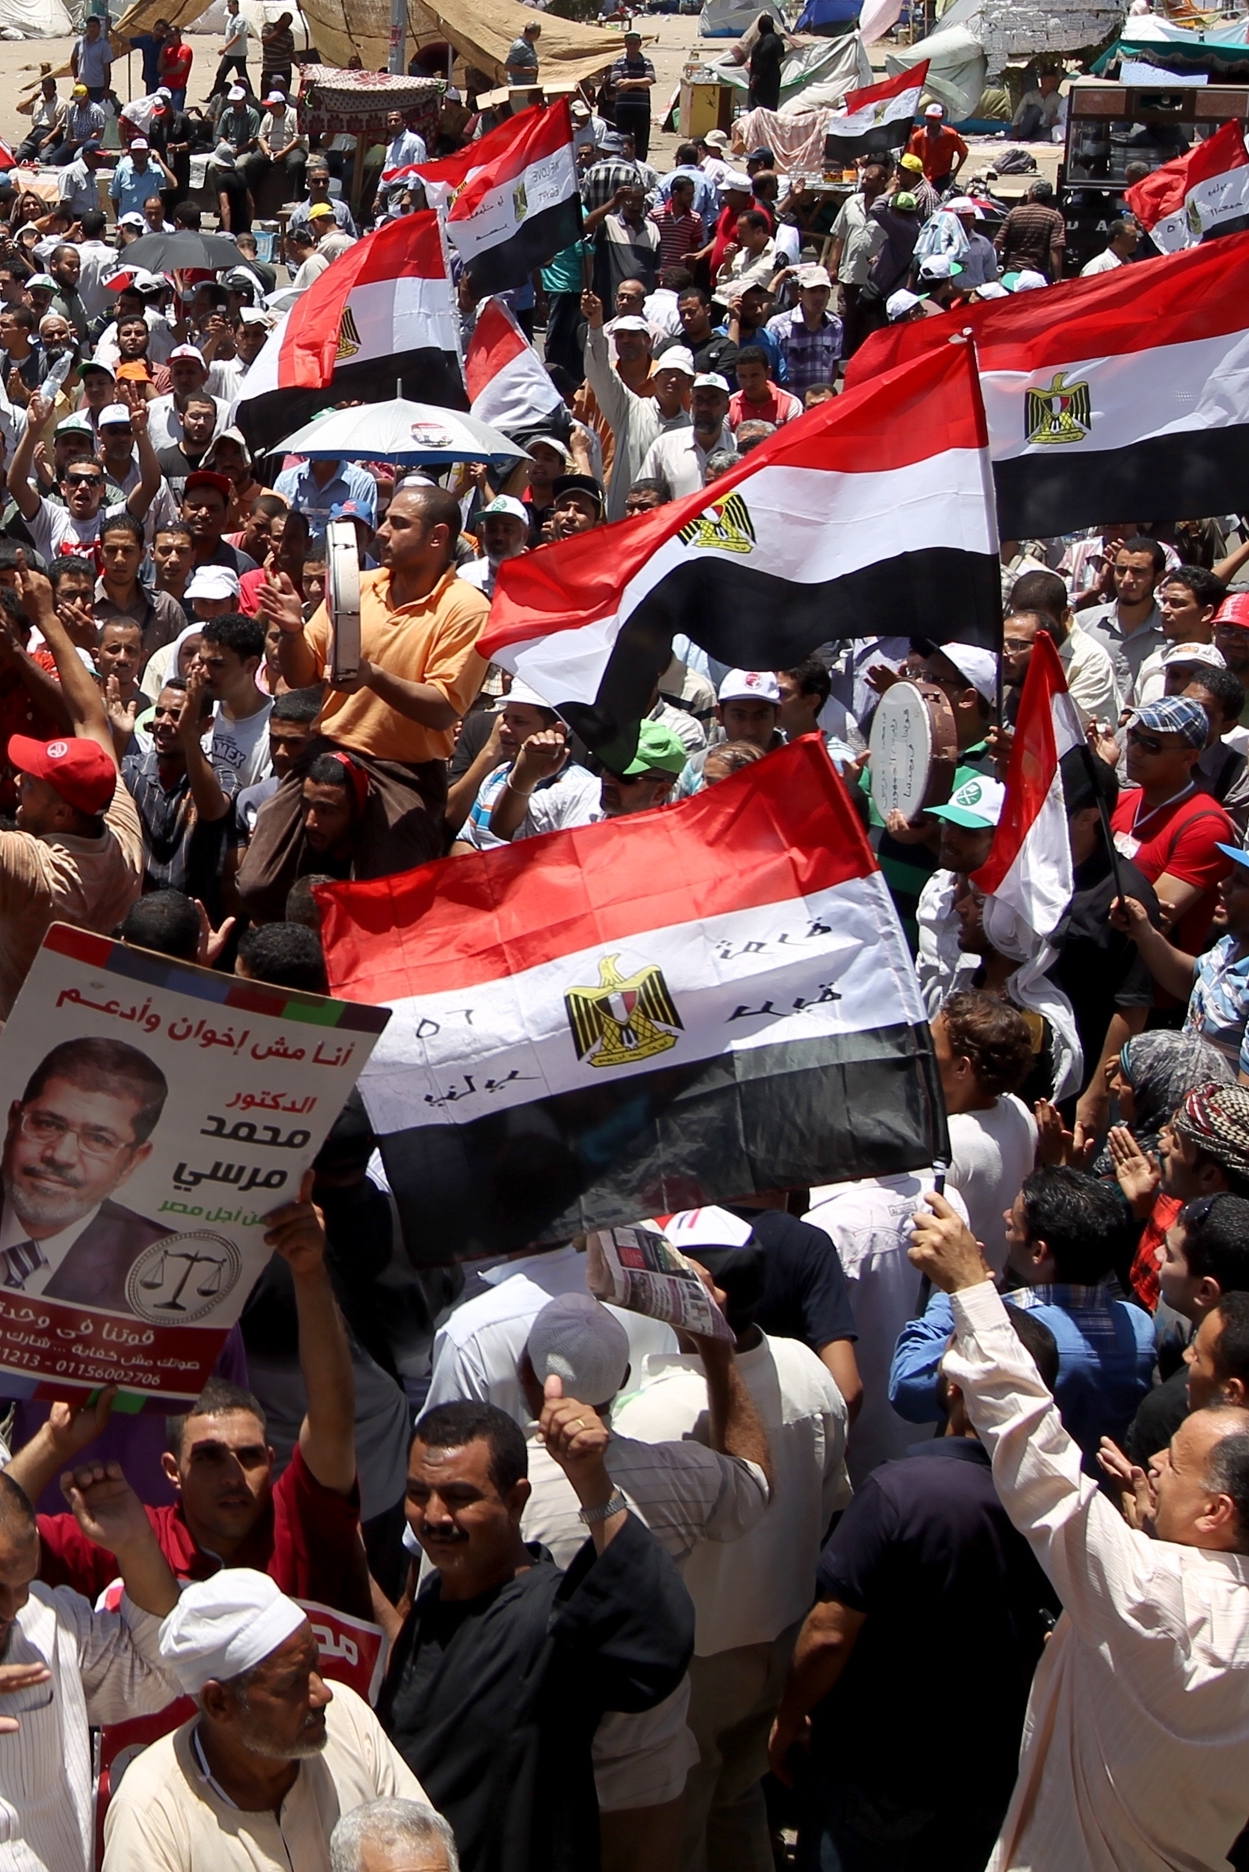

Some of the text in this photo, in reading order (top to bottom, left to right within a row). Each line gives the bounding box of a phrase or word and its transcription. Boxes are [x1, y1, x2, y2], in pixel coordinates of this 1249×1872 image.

[56, 986, 357, 1067] أنا مش إخوان وأدعم
[225, 1090, 318, 1114] الدكتور
[200, 1115, 311, 1149] محمد
[173, 1161, 288, 1192] مرسي
[157, 1200, 266, 1227] من أجل مصر
[6, 1330, 50, 1350] شارك
[102, 1322, 155, 1347] قوتنا
[72, 1341, 117, 1363] كفاية
[121, 1353, 154, 1366] مش
[157, 1357, 200, 1371] صوتك
[56, 1360, 161, 1386] 01156002706
